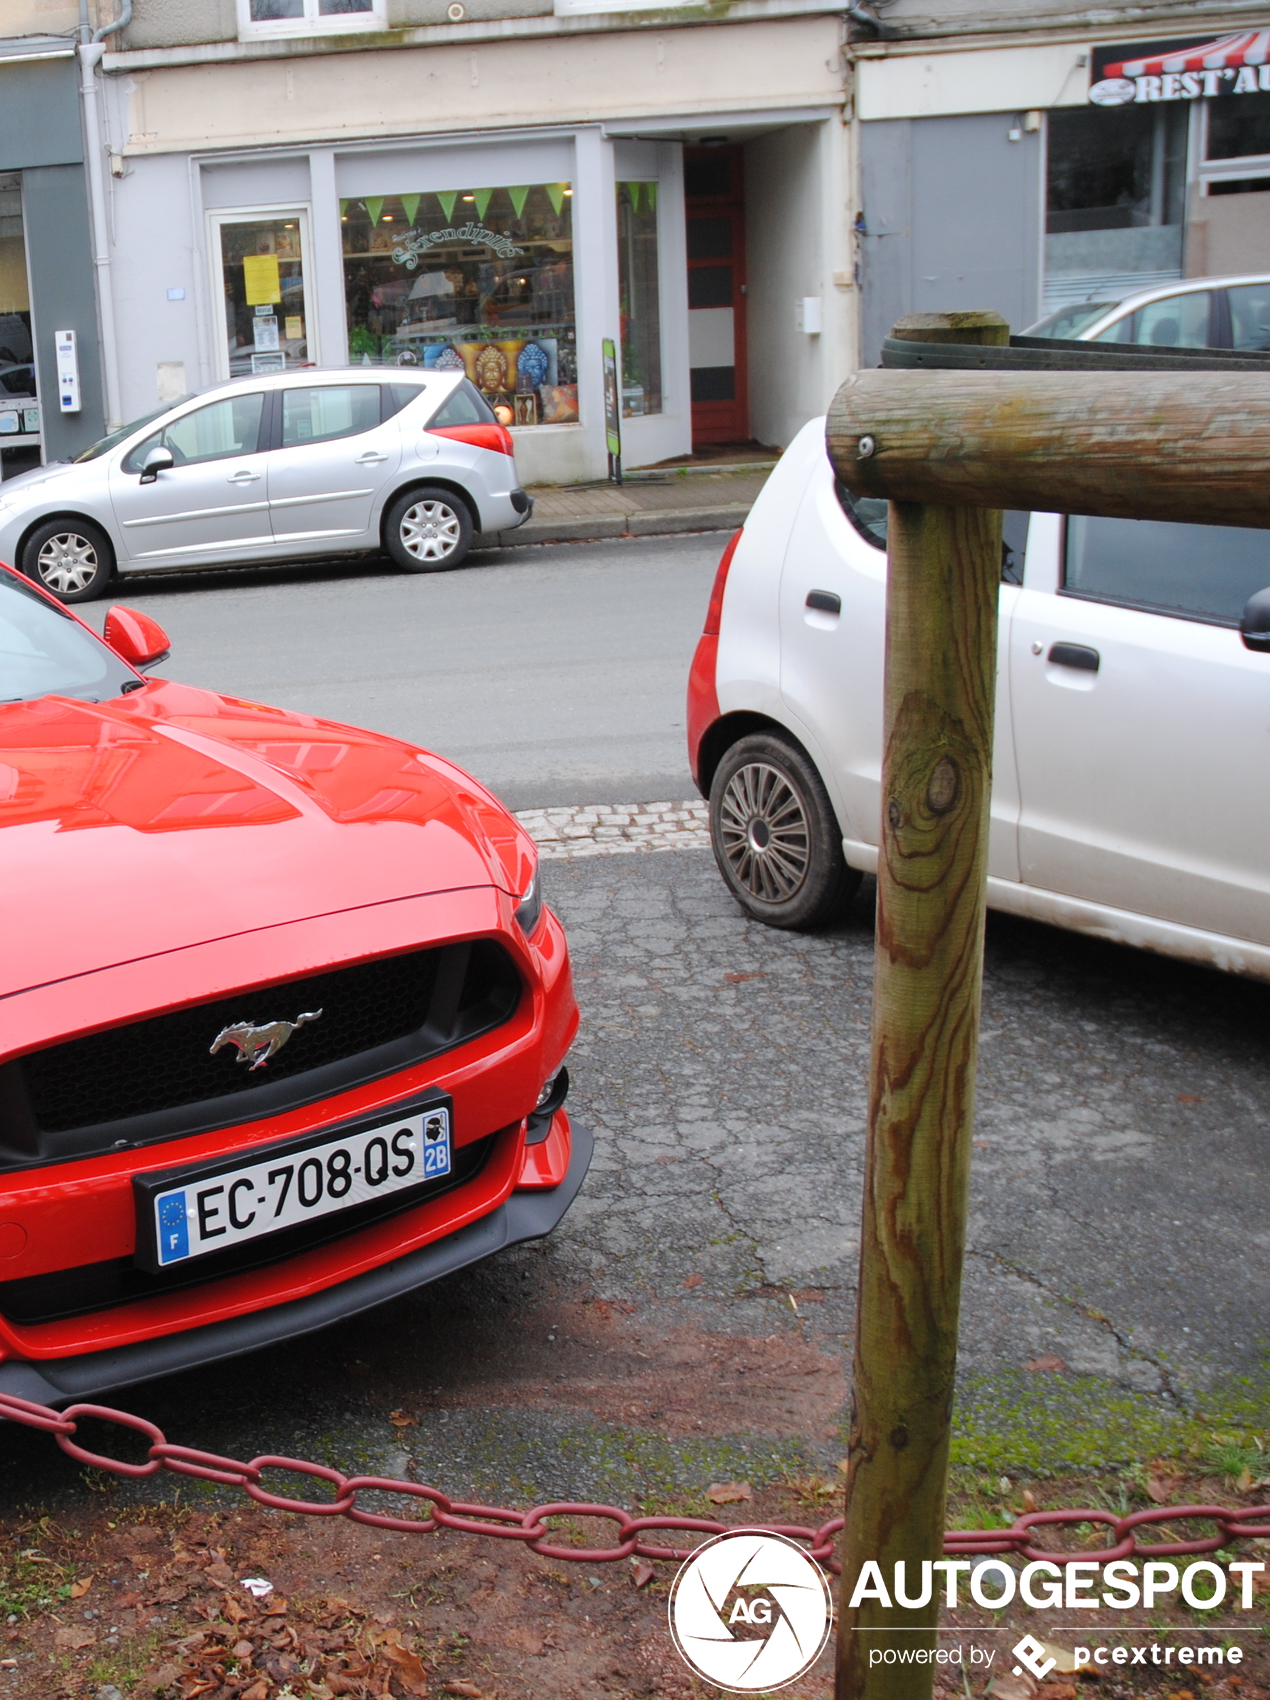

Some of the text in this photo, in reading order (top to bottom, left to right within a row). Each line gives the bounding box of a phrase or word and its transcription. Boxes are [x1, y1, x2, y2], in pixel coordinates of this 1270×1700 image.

[392, 222, 524, 270] Serendipité
[425, 1145, 447, 1172] 2B
[197, 1128, 415, 1240] EC-708-QS
[169, 1233, 179, 1250] F
